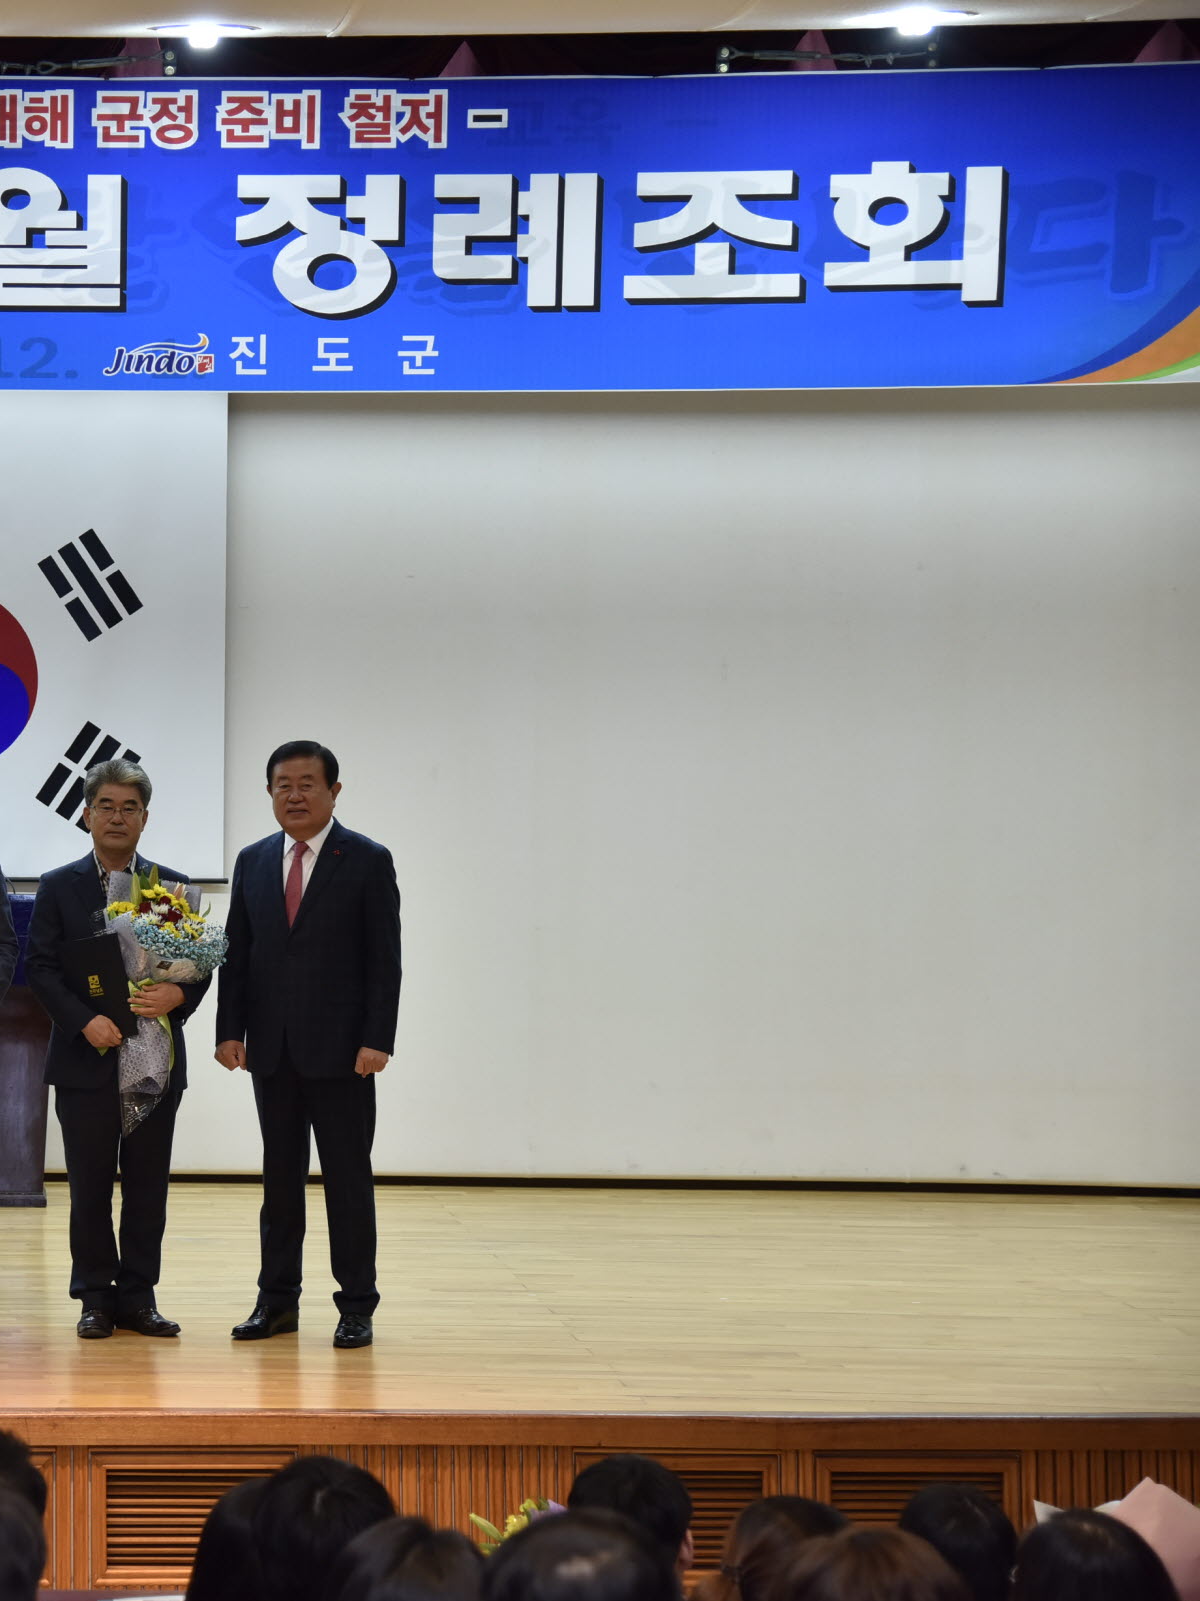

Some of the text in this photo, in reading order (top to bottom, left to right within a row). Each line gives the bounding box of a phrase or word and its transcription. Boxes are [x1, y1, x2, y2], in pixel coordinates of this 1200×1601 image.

[91, 89, 198, 149] 군정
[216, 89, 321, 149] 준비
[338, 88, 448, 149] 철저
[236, 161, 1009, 320] 정례조회
[103, 346, 197, 376] Jindo
